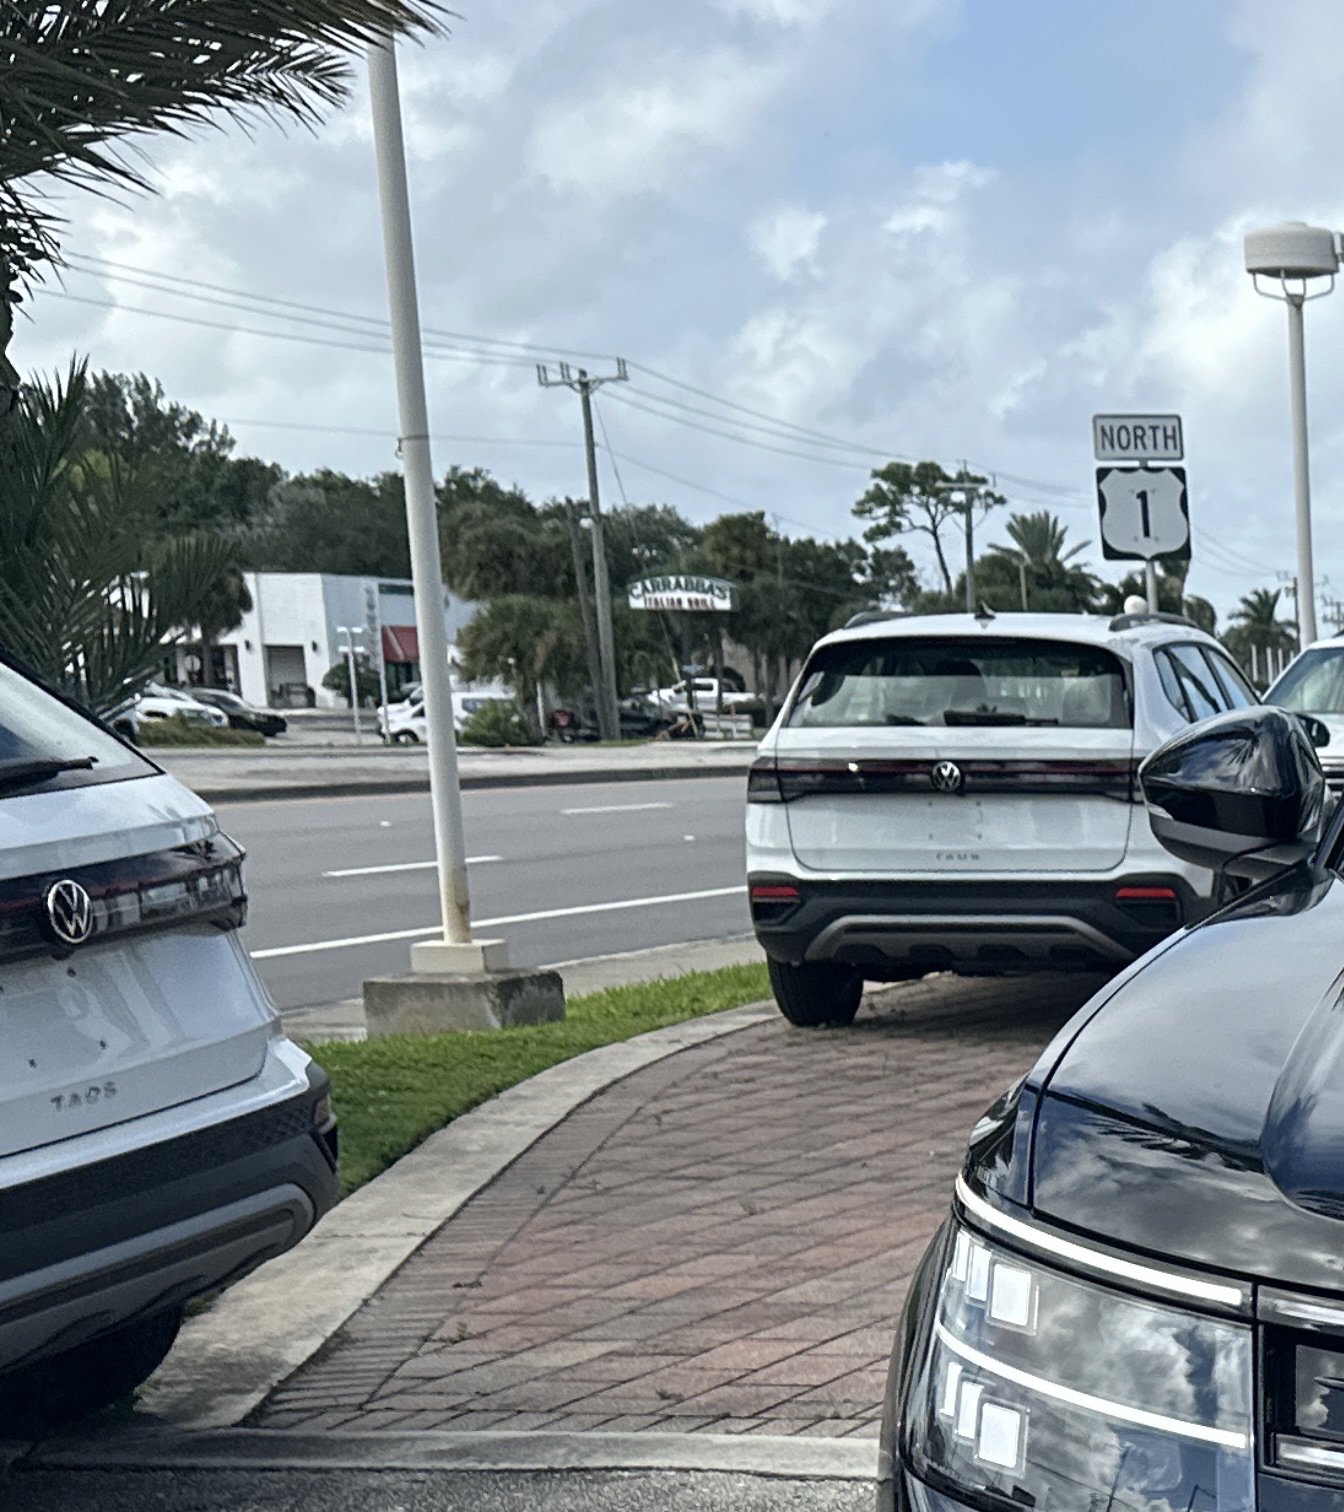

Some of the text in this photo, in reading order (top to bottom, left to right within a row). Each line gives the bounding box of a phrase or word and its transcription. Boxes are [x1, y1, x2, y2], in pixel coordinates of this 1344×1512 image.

[1100, 424, 1178, 451] NORTH
[1135, 489, 1151, 539] 1
[48, 881, 91, 941] VW
[50, 1080, 118, 1113] TAOS
